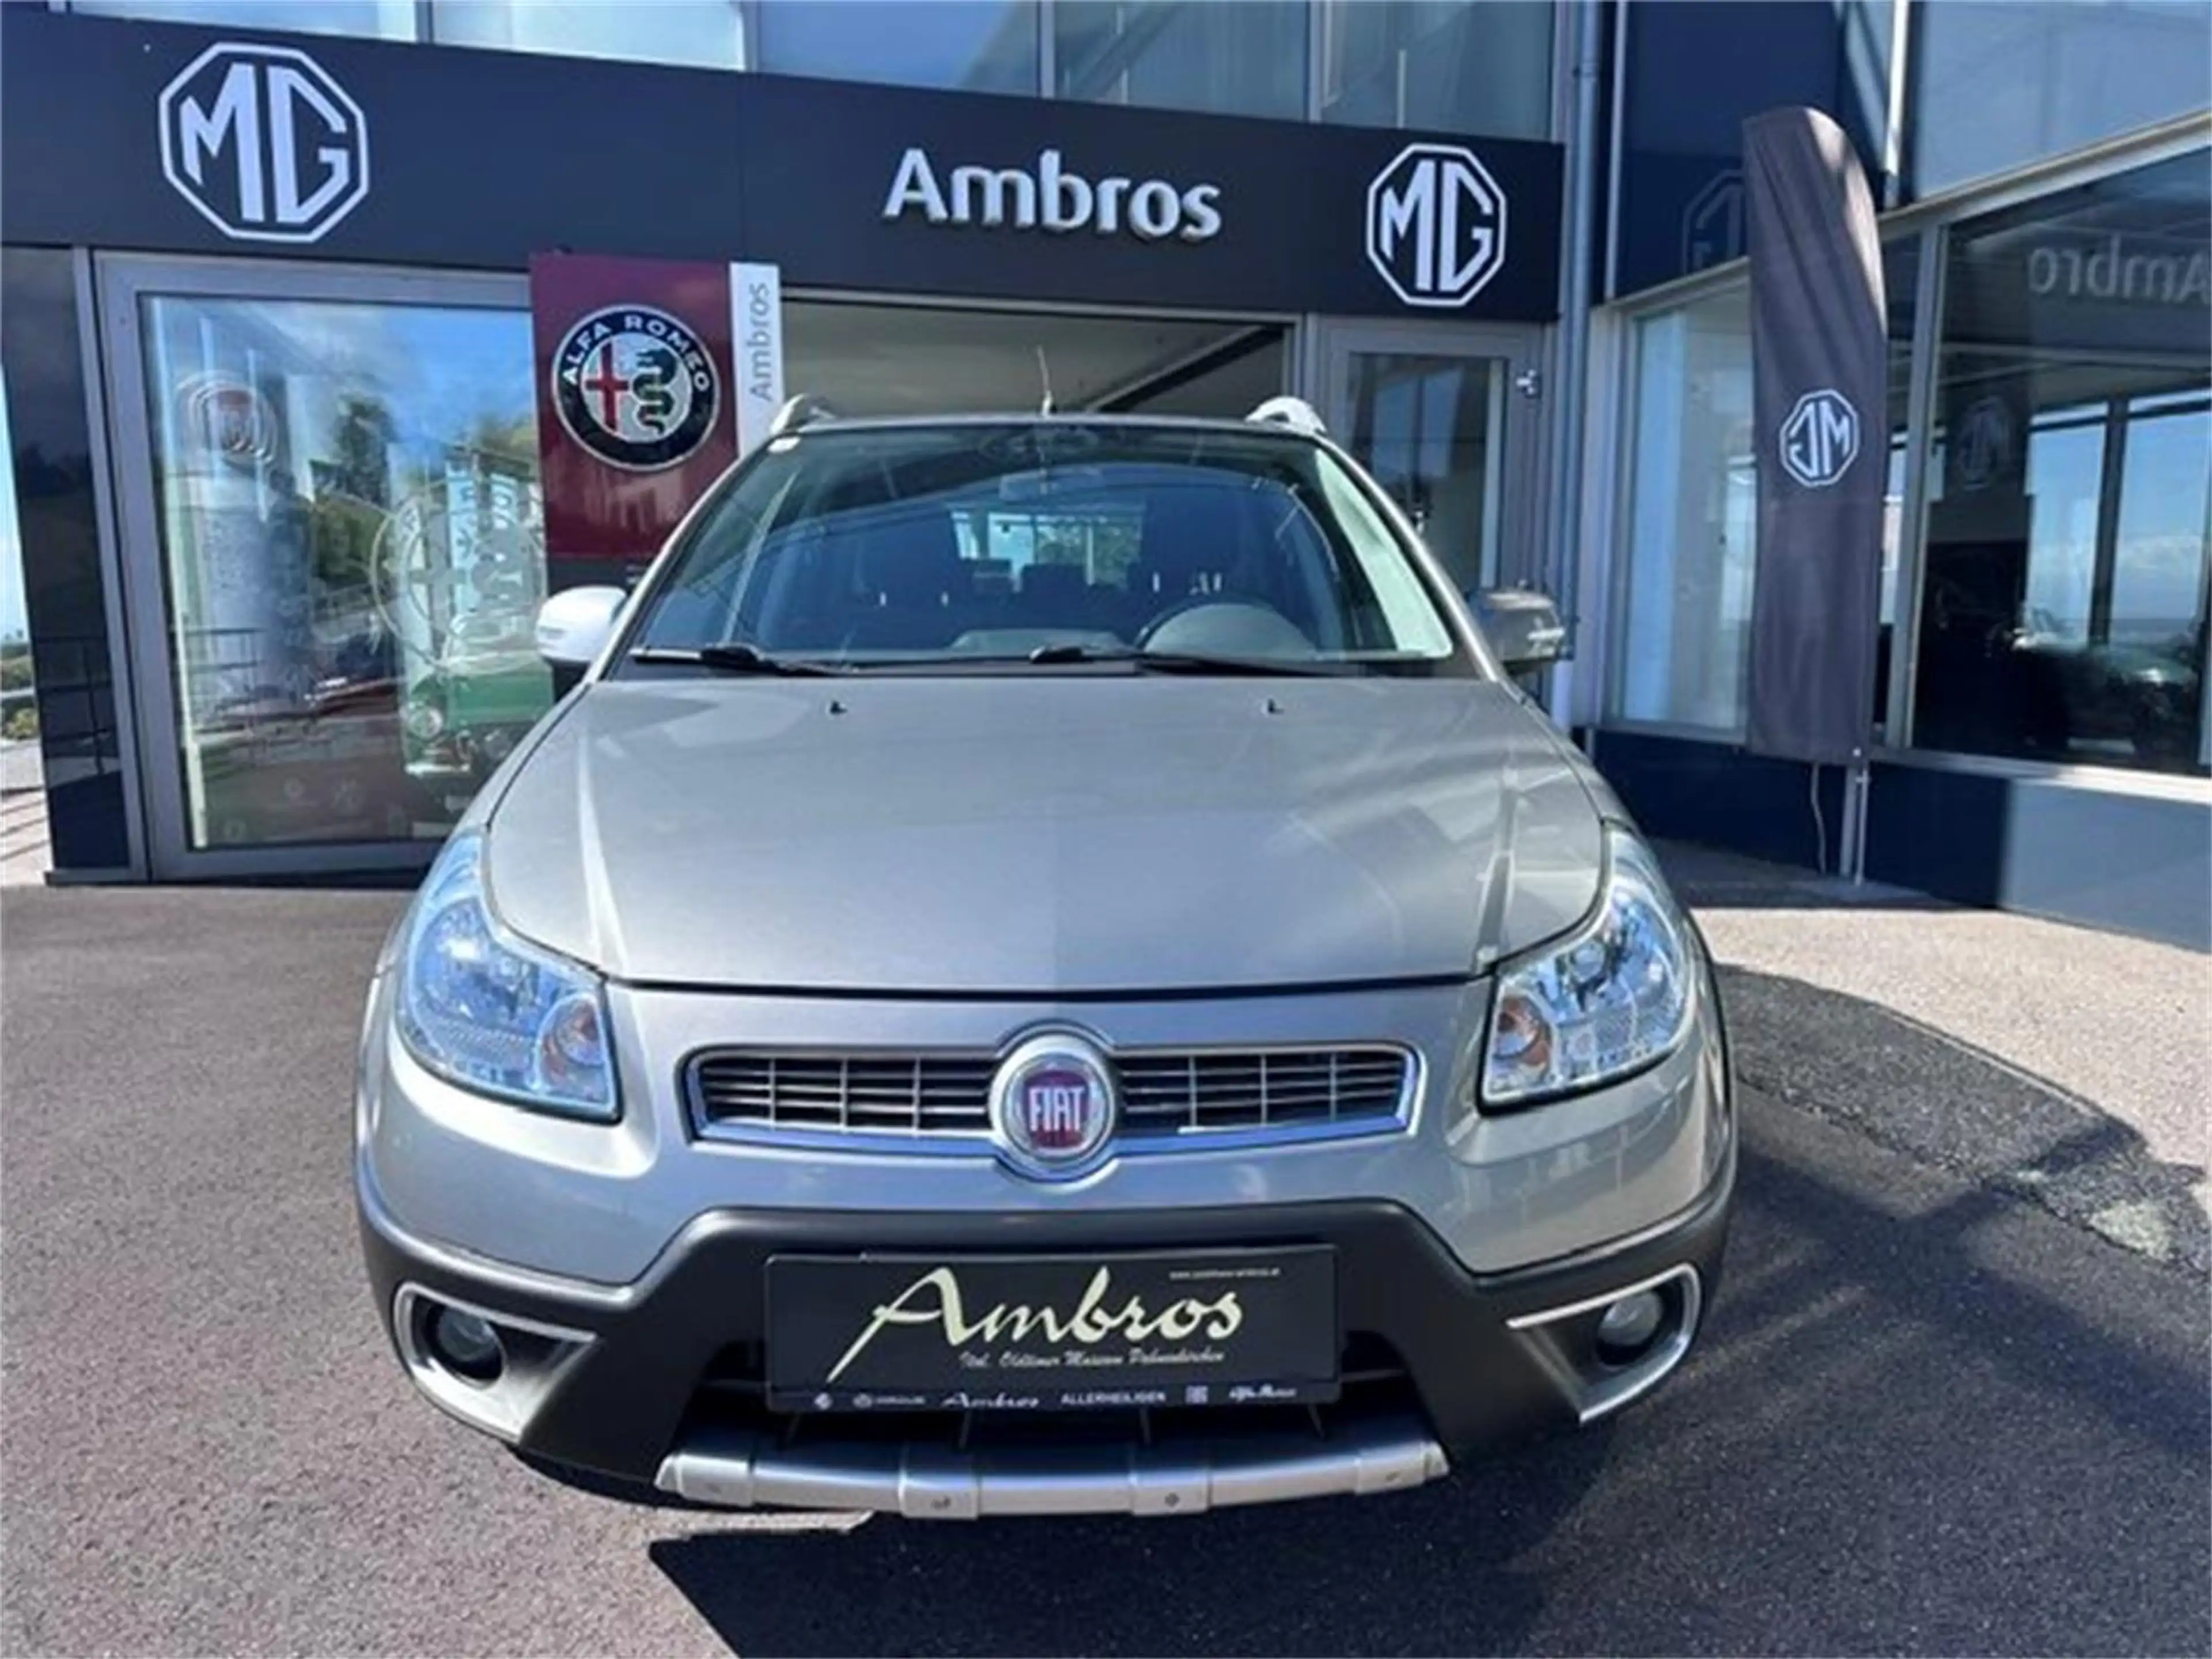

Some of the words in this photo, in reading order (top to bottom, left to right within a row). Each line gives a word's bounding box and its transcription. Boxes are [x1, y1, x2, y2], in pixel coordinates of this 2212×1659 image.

[180, 62, 350, 223] MG
[882, 147, 1221, 240] Ambros
[1380, 158, 1493, 291] MG
[563, 322, 611, 385] ALFA
[623, 315, 710, 392] ROMEO
[746, 282, 774, 402] Ambros
[1028, 1085, 1085, 1132] FIAT
[827, 1266, 1242, 1382] Ambros
[941, 1392, 1039, 1408] Ambros
